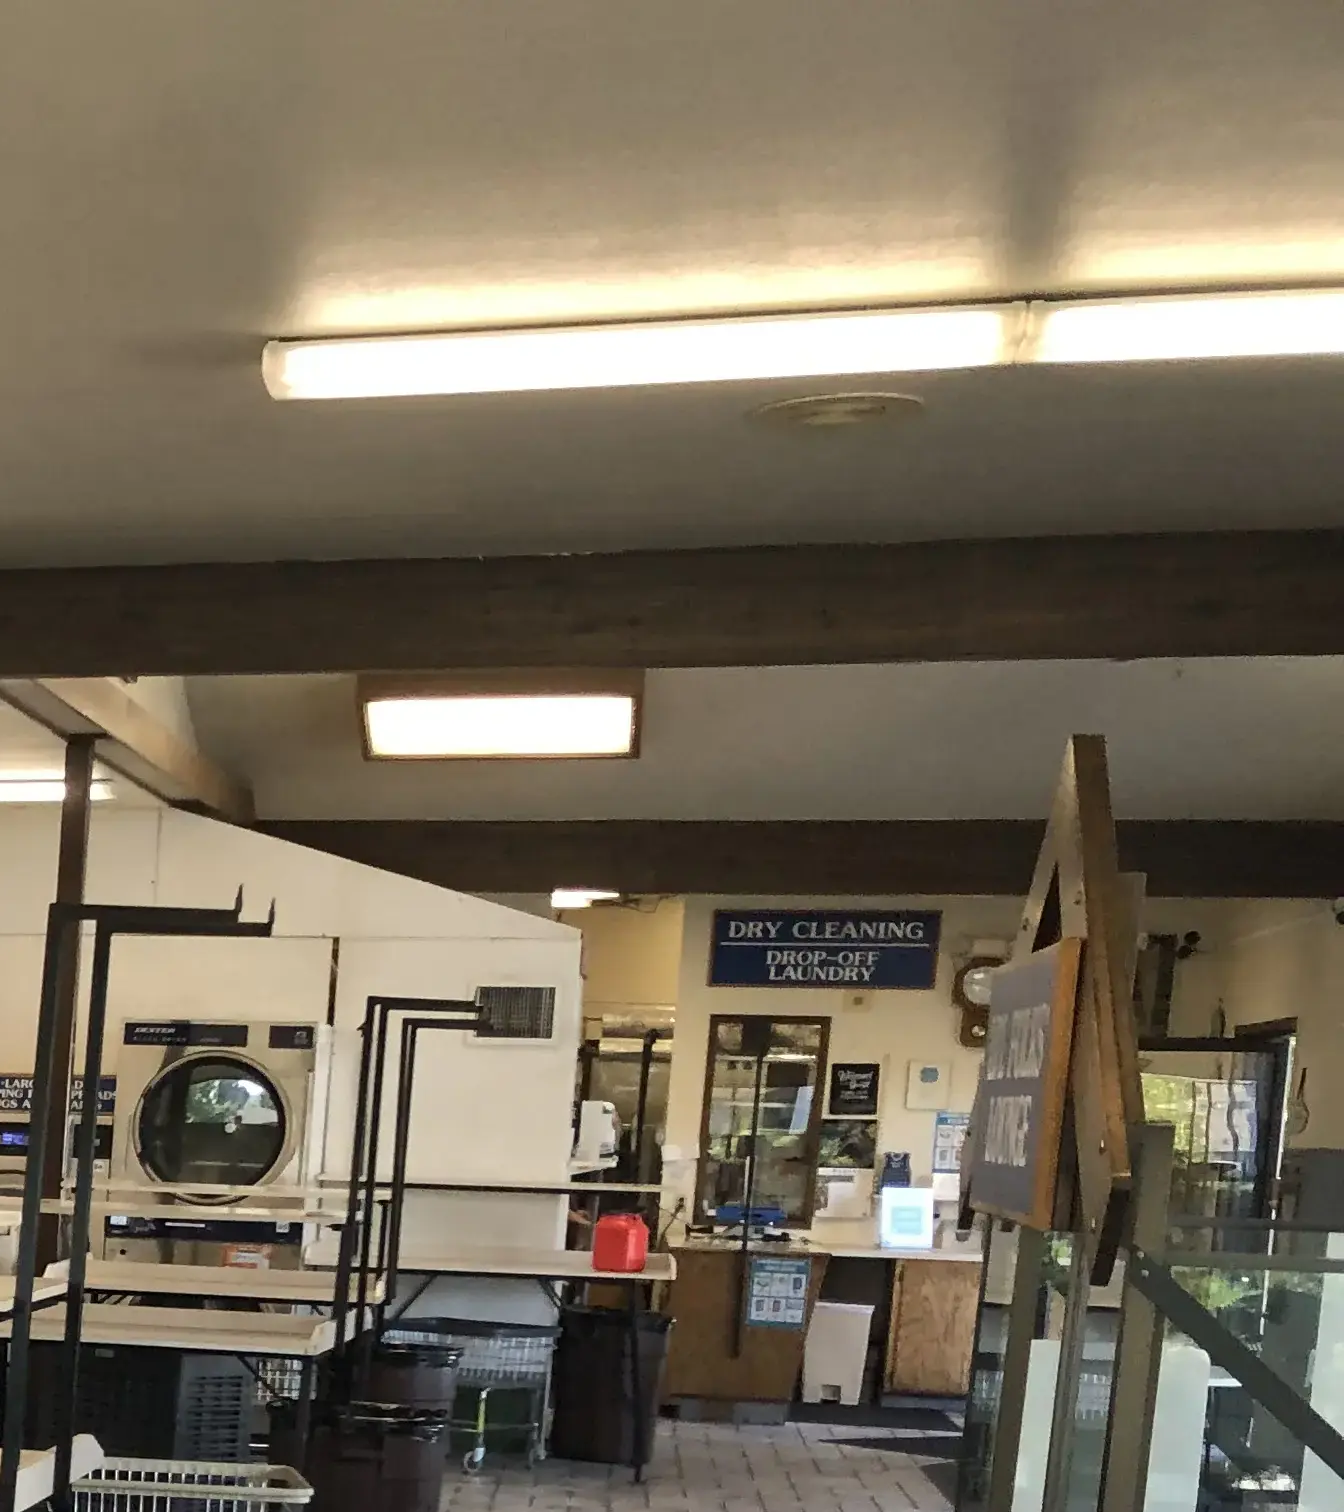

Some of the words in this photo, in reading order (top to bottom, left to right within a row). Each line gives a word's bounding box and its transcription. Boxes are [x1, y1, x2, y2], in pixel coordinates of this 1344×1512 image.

[728, 920, 783, 938] DRY
[792, 921, 924, 939] CLEANING
[766, 950, 880, 966] DROP-OFF
[768, 966, 876, 982] LAUNDRY
